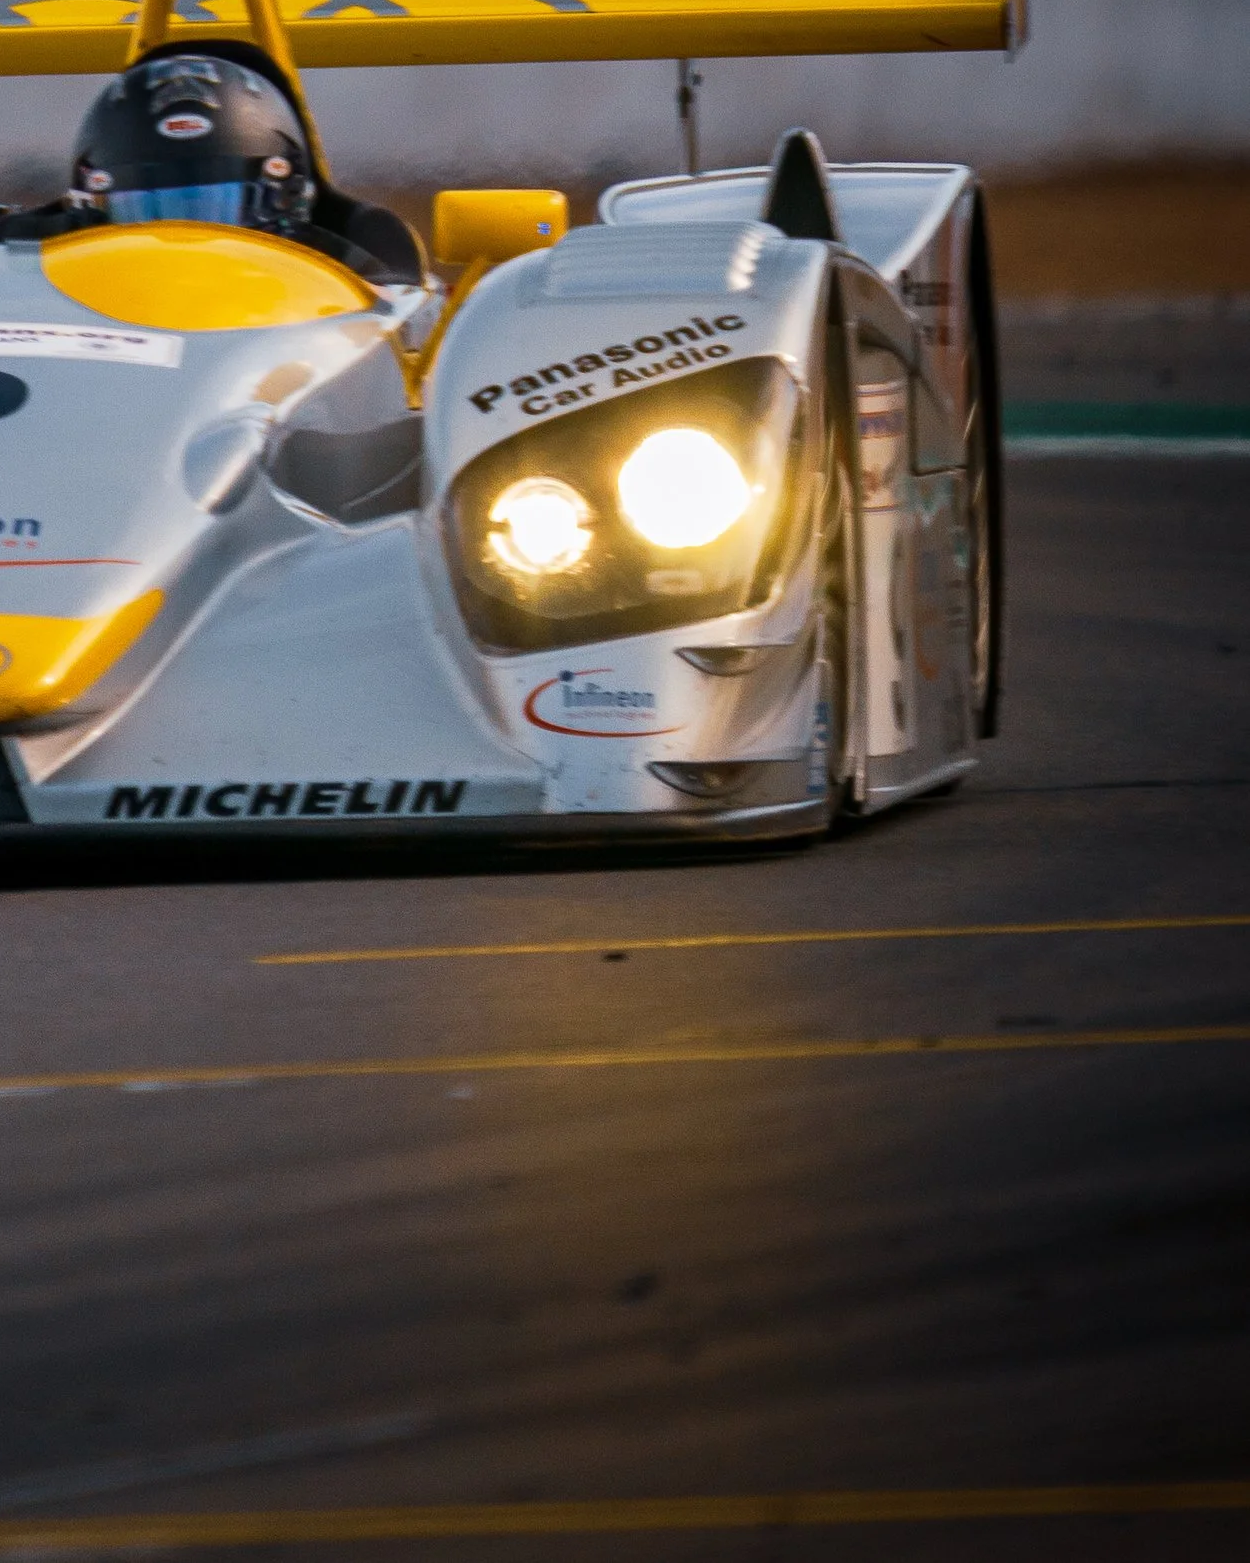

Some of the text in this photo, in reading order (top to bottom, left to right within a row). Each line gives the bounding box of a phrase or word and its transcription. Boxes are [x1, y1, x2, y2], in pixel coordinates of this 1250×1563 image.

[468, 313, 747, 415] Panasonic
[519, 343, 733, 417] Car Audio
[104, 779, 470, 820] MICHELIN
